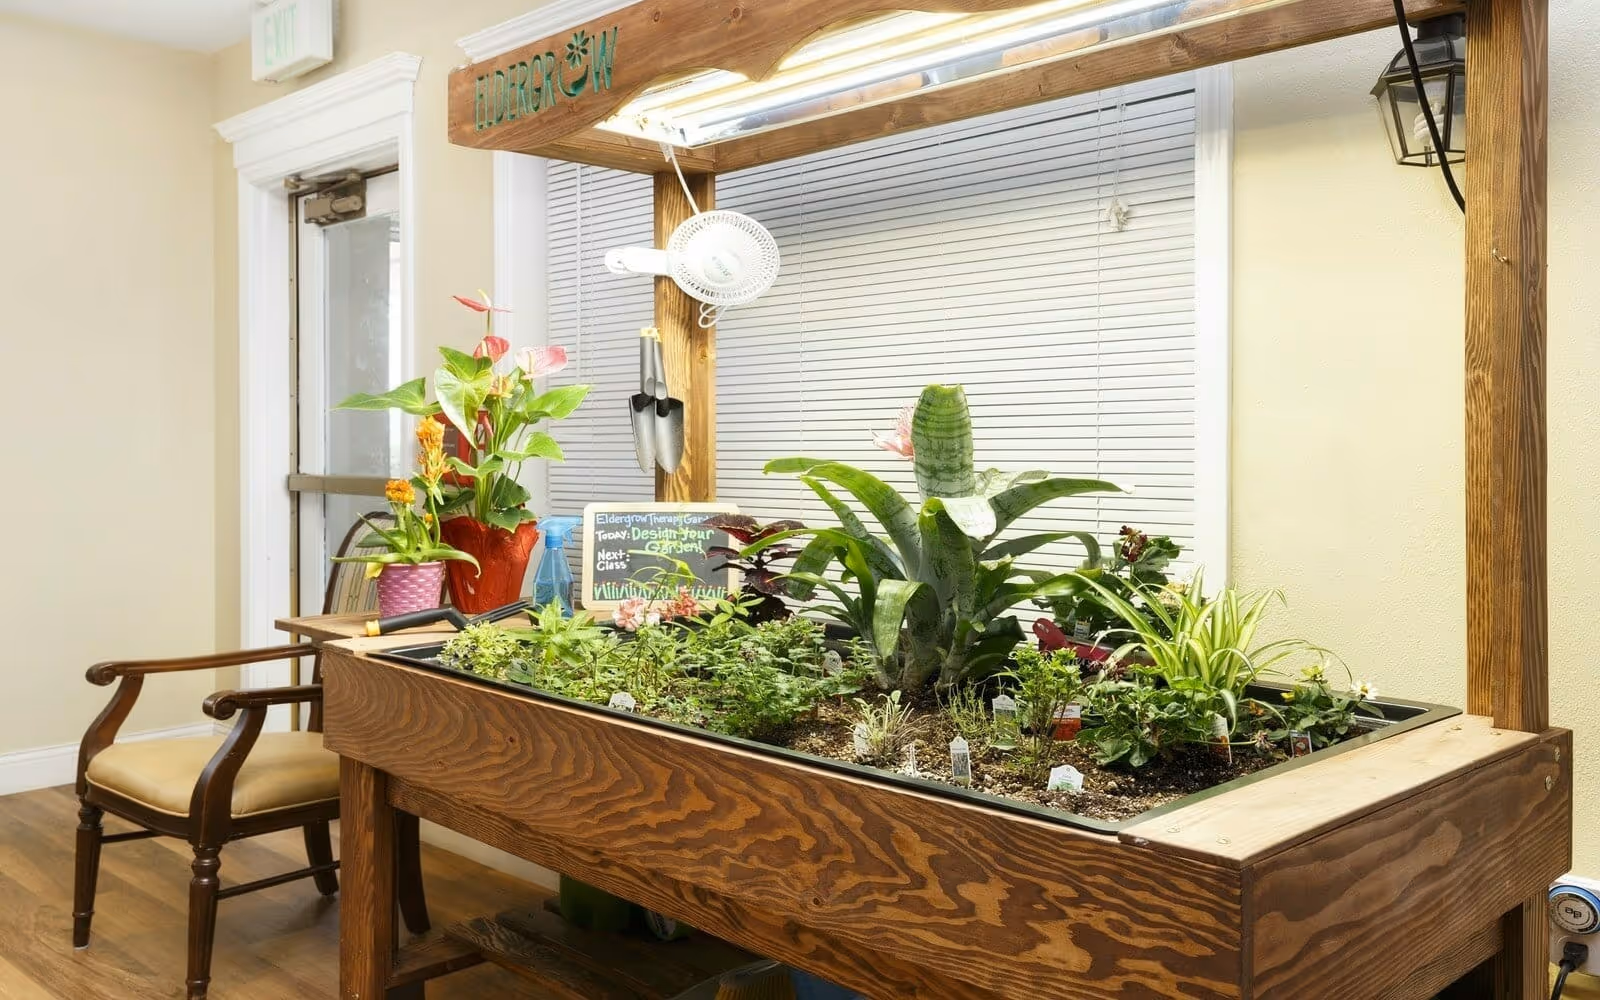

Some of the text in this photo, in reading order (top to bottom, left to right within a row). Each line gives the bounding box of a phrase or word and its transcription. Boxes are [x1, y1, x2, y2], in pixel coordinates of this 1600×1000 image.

[263, 3, 297, 66] EXIT
[474, 26, 618, 132] ELDERGROW
[646, 512, 683, 527] Therapy
[631, 526, 677, 541] Design
[596, 560, 627, 571] Class
